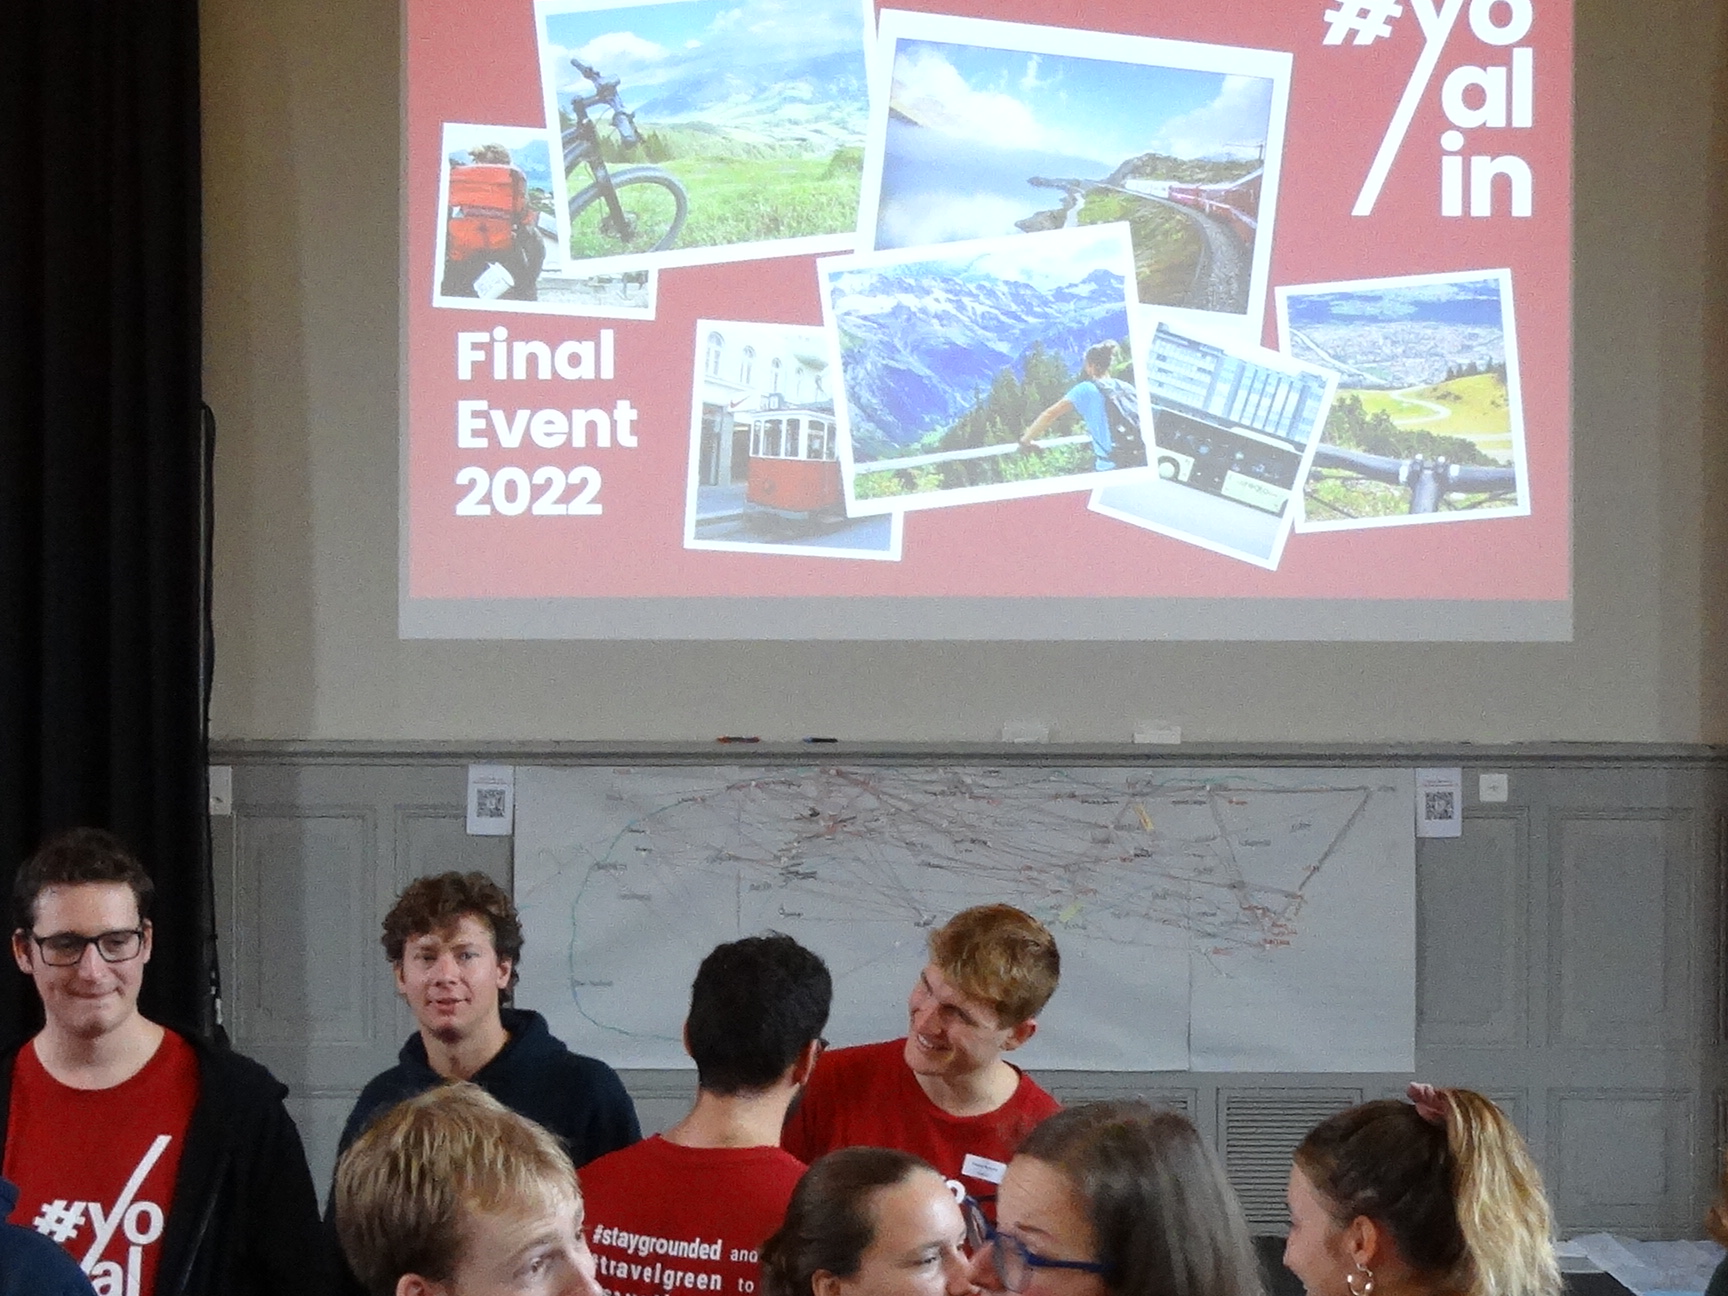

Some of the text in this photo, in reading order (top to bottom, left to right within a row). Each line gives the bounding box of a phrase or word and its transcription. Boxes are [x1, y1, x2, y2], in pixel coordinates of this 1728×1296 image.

[1441, 47, 1533, 128] al
[1440, 130, 1533, 217] in
[457, 326, 614, 380] Final
[457, 400, 638, 448] Event
[455, 466, 603, 516] 2022
[593, 1224, 723, 1262] #staygrounded
[738, 1277, 755, 1293] to
